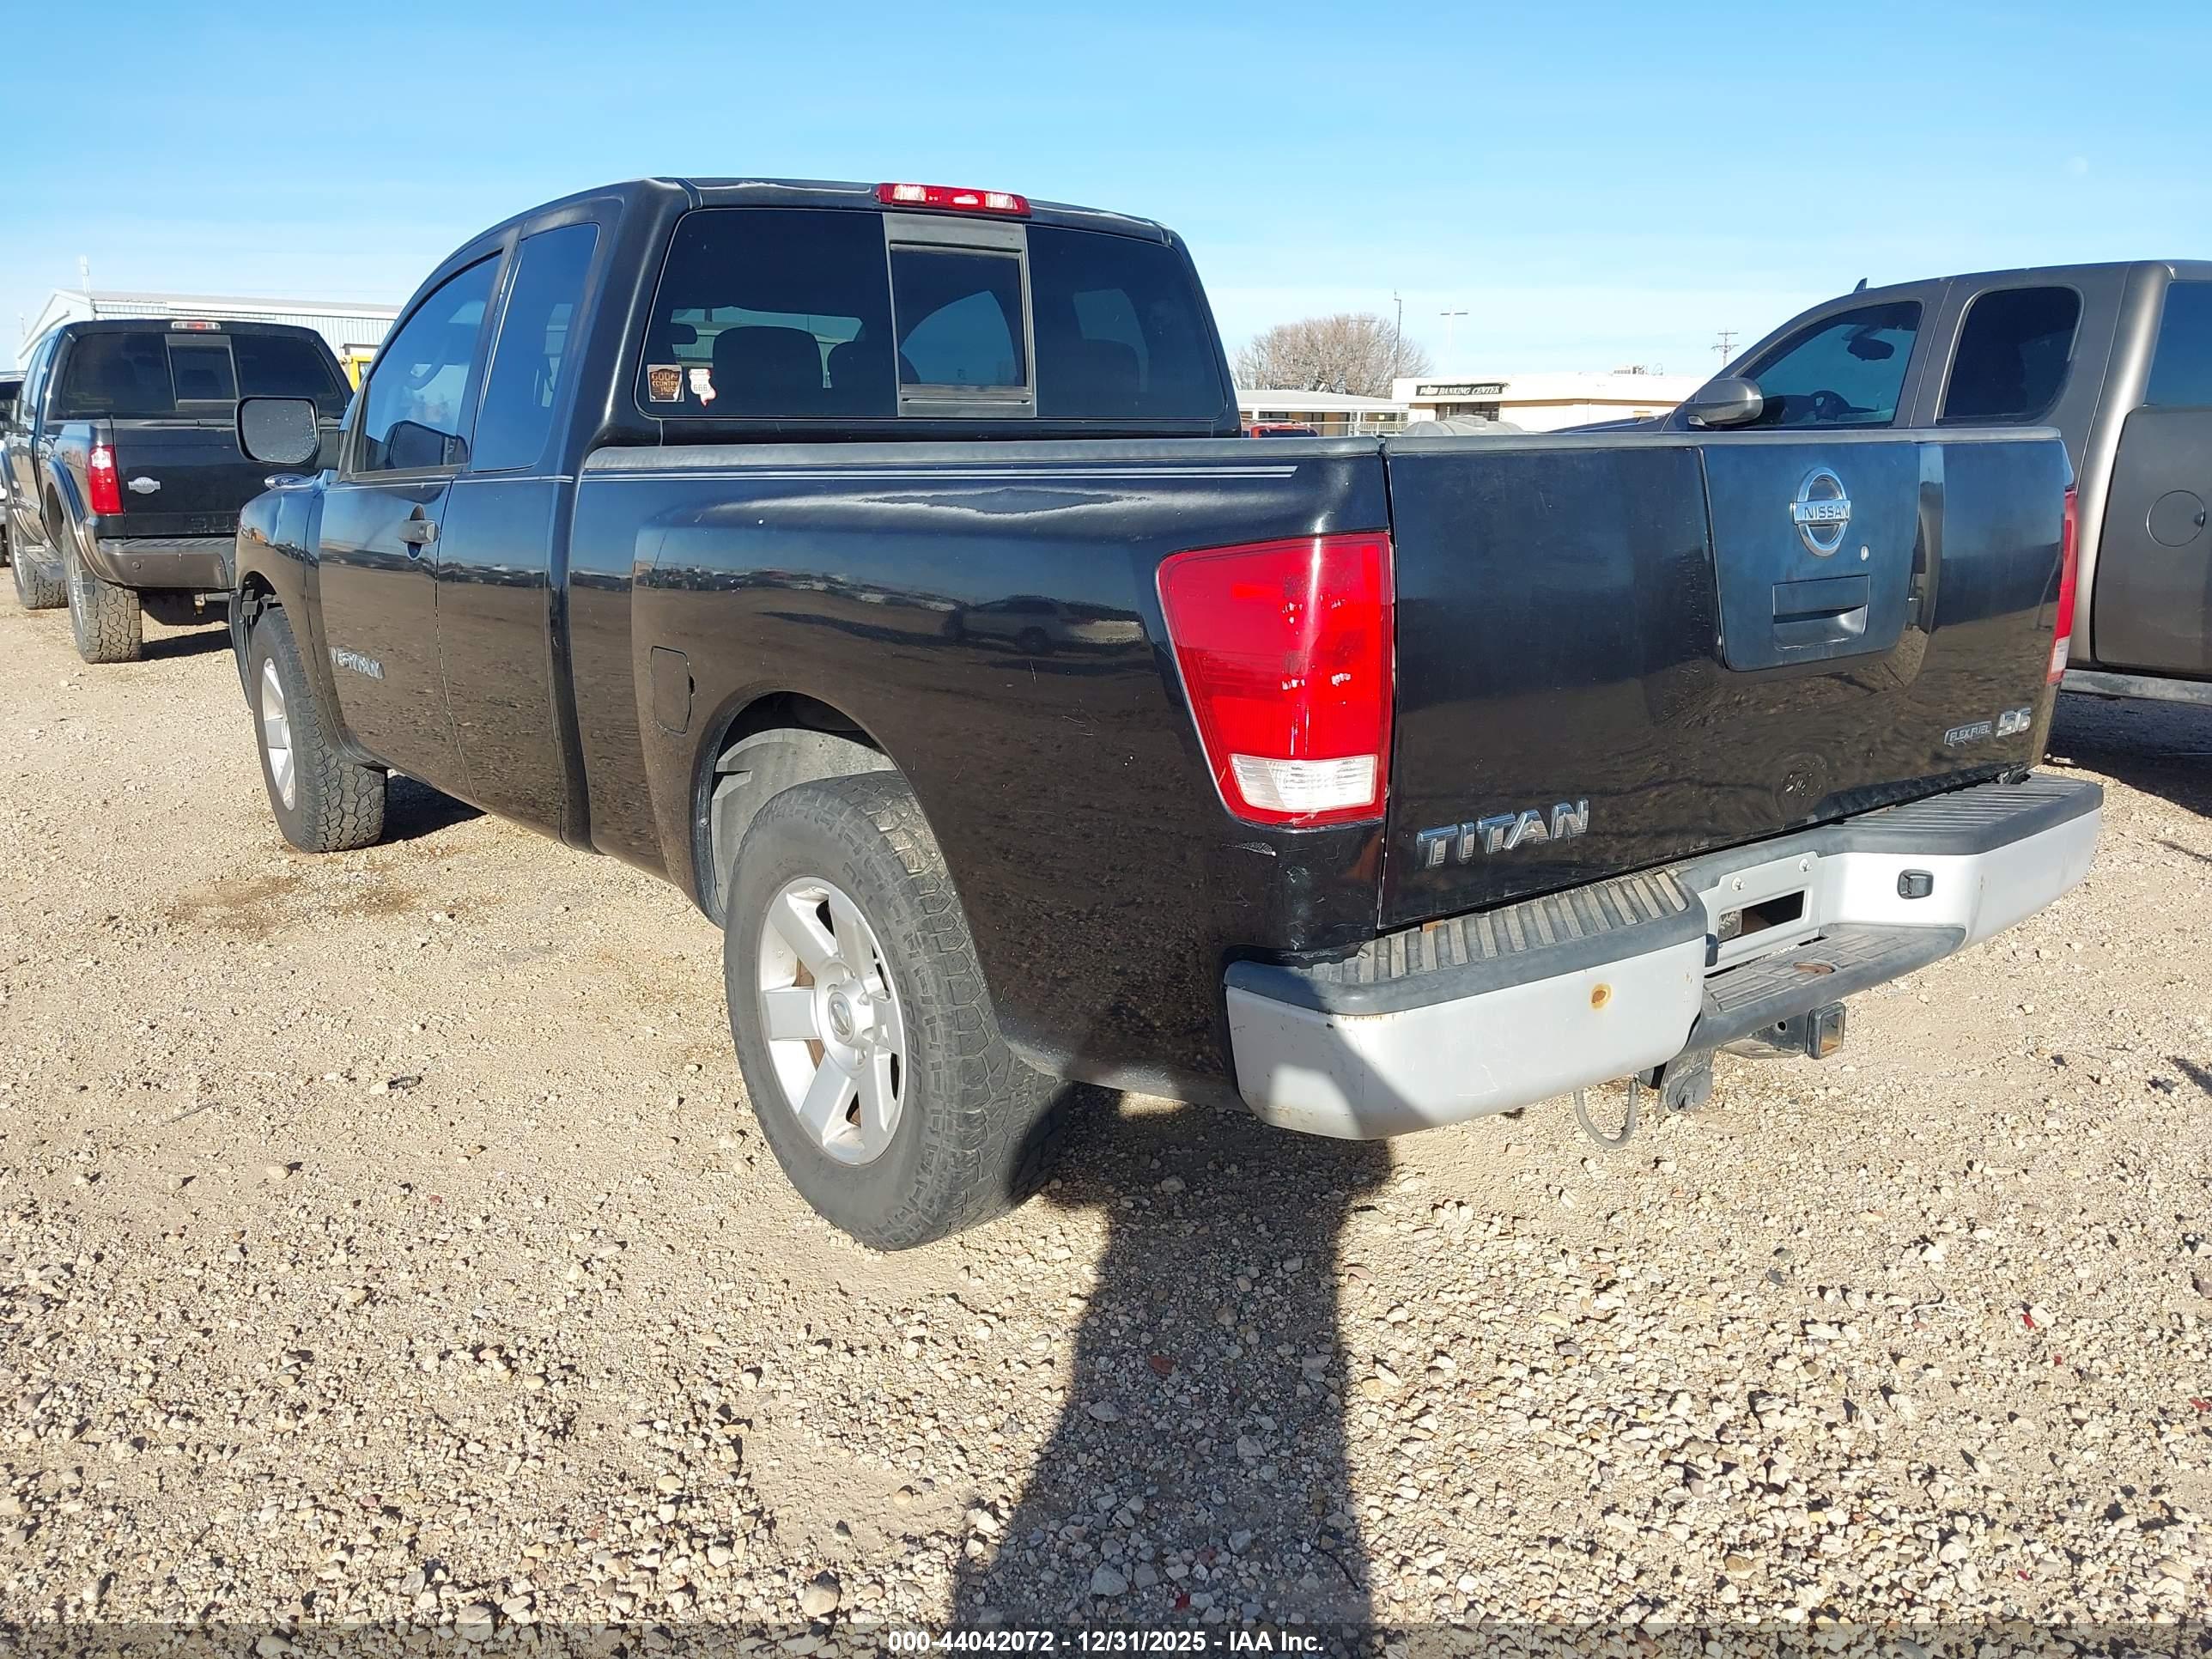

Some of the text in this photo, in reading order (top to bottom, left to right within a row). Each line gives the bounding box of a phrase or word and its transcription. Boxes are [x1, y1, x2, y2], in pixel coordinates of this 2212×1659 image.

[1438, 386, 1471, 395] BANKING
[1471, 386, 1500, 395] CENTER
[1804, 504, 1850, 520] NISSAN
[1417, 798, 1589, 867] TITAN
